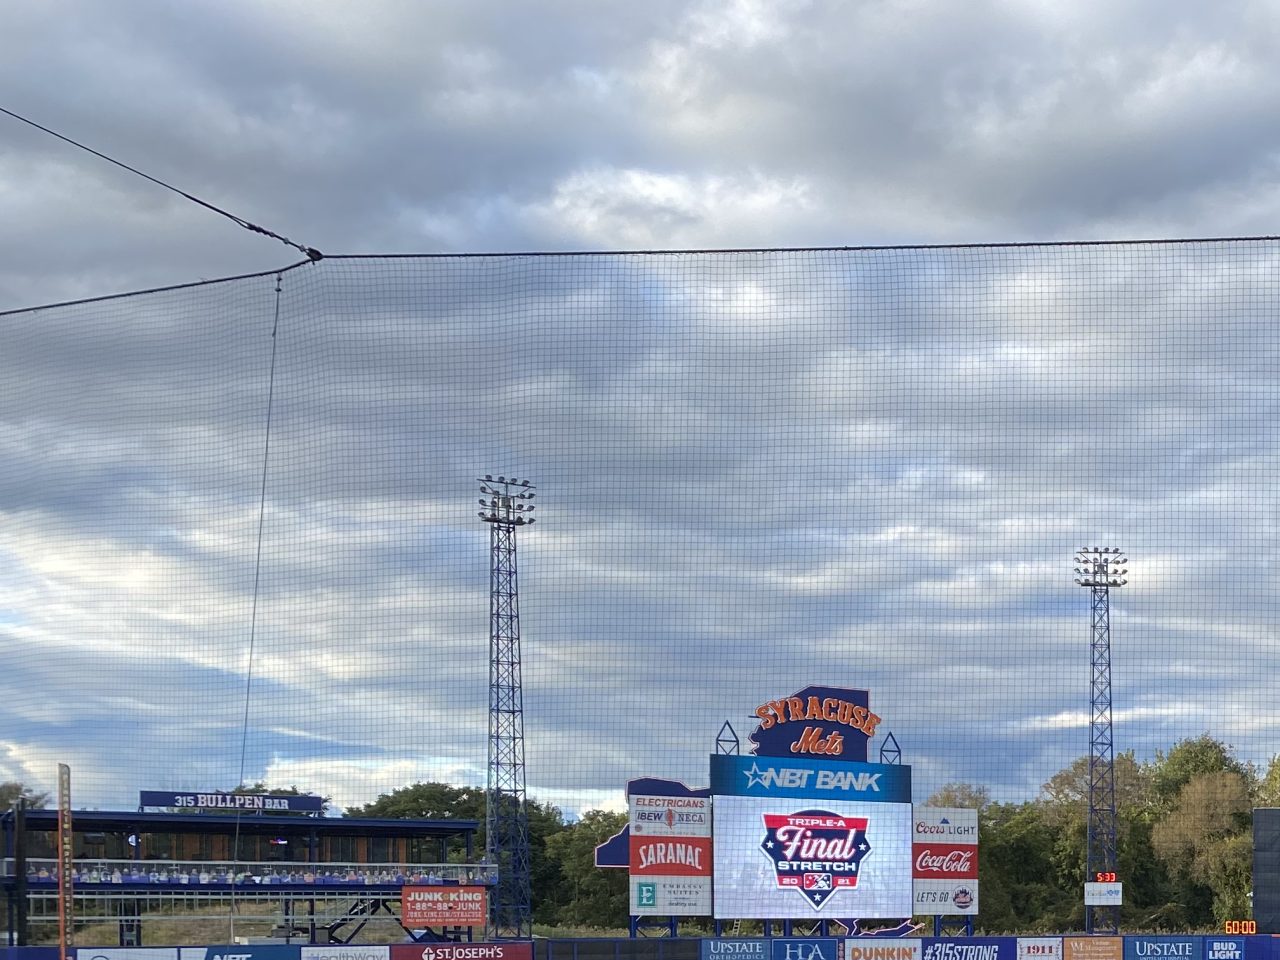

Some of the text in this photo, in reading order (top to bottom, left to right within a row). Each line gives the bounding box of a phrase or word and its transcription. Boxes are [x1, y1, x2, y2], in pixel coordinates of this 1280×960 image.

[755, 696, 881, 737] SYRACUSE
[790, 727, 844, 755] Mets
[764, 767, 883, 792] NBT BANK
[174, 794, 289, 810] 315 BULLPEN BAR
[636, 797, 705, 808] ELECTRICIANS
[637, 812, 704, 823] IBEW NECA
[787, 818, 846, 827] TRIPLE-A
[916, 821, 976, 835] Coors LIGHT
[776, 825, 856, 861] Final
[639, 842, 702, 870] SARANAC
[777, 861, 856, 872] STRETCH
[1096, 872, 1116, 882] 5:33
[407, 889, 482, 902] JUNK KING
[641, 886, 653, 904] E
[916, 892, 937, 903] LET'S
[938, 892, 949, 903] GO
[1225, 920, 1256, 934] 60:00
[710, 941, 763, 953] UPSTATE
[1026, 945, 1053, 954] 1911
[1135, 941, 1193, 955] UPSTATE
[1213, 942, 1237, 950] BUD
[851, 947, 917, 960] DUNKIN'
[1208, 950, 1241, 960] LIGHT
